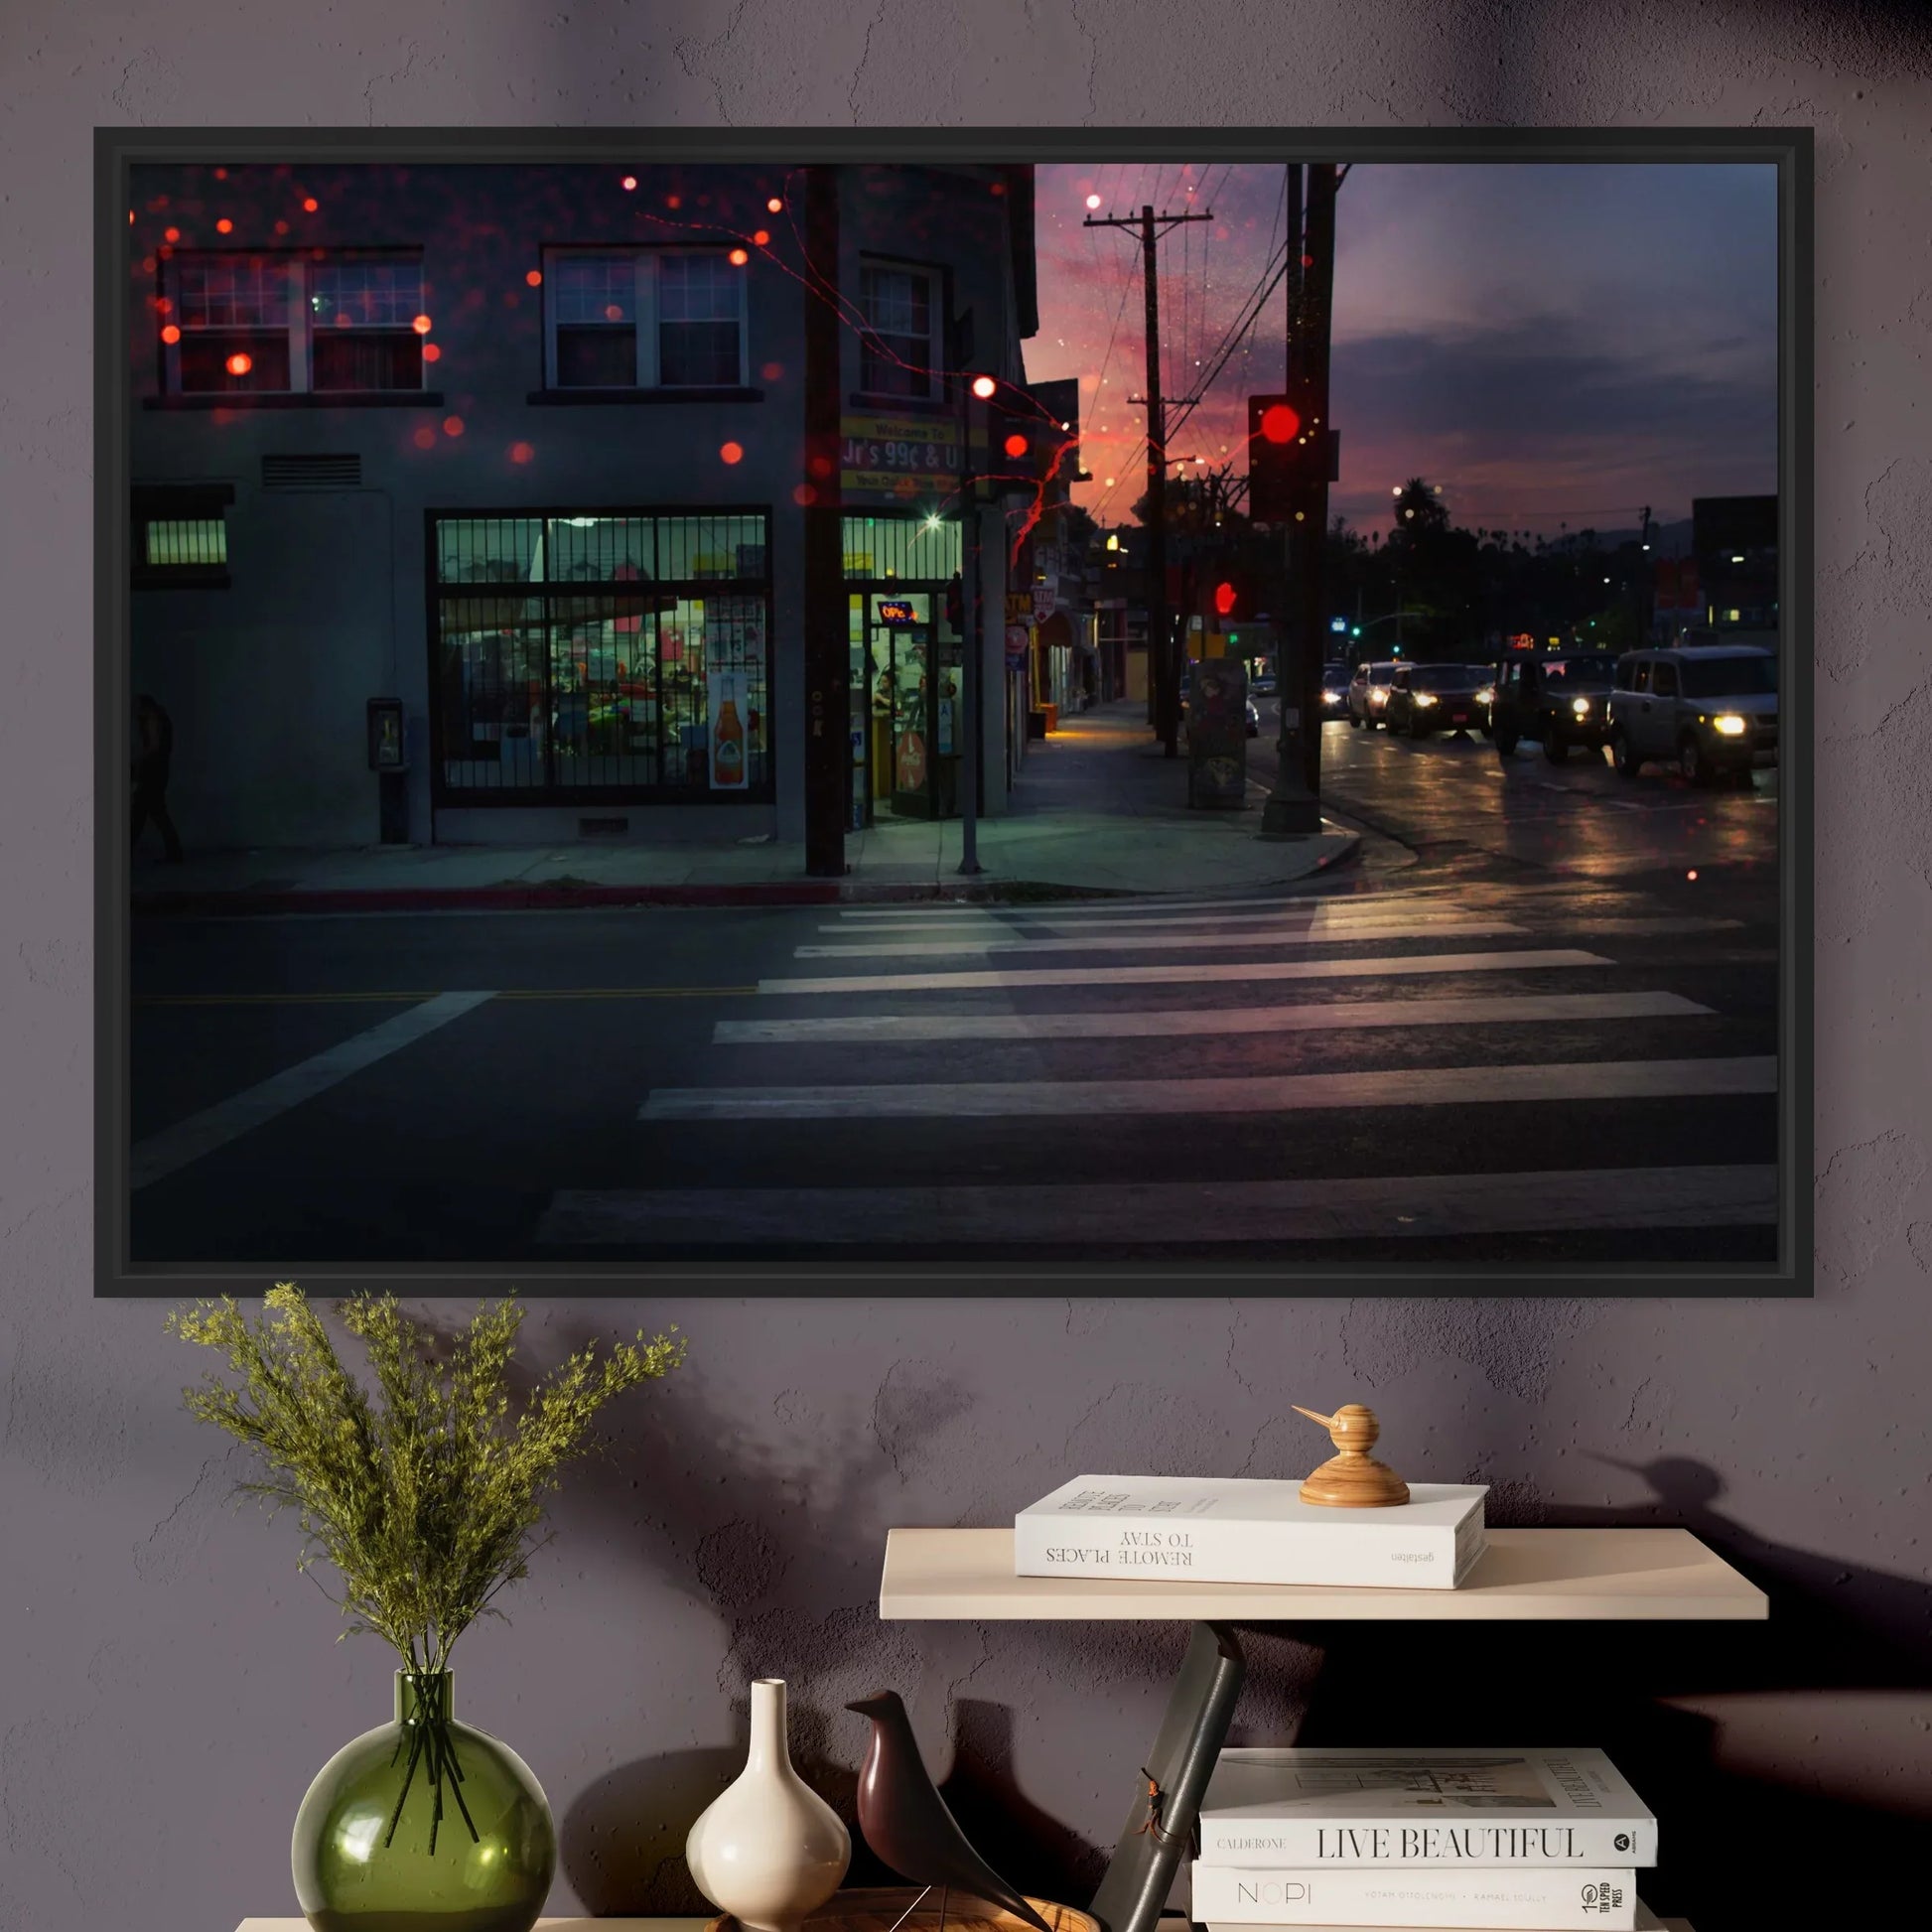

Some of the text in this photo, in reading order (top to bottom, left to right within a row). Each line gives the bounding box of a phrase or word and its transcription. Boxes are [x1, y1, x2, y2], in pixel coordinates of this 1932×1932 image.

[876, 423, 944, 440] Welcome To
[843, 438, 879, 466] Jr's
[885, 441, 918, 471] 99¢
[925, 444, 939, 469] &
[1121, 1532, 1193, 1547] TO STAY
[1045, 1548, 1192, 1566] REMOTE PLACES
[1391, 1552, 1435, 1563] gestalten
[1217, 1838, 1287, 1850] CALDERONE
[1316, 1828, 1584, 1859] LIVE BEAUTIFUL
[1238, 1882, 1311, 1904] NOPI
[1599, 1881, 1610, 1914] TEN SPEED
[1611, 1888, 1622, 1908] PRESS
